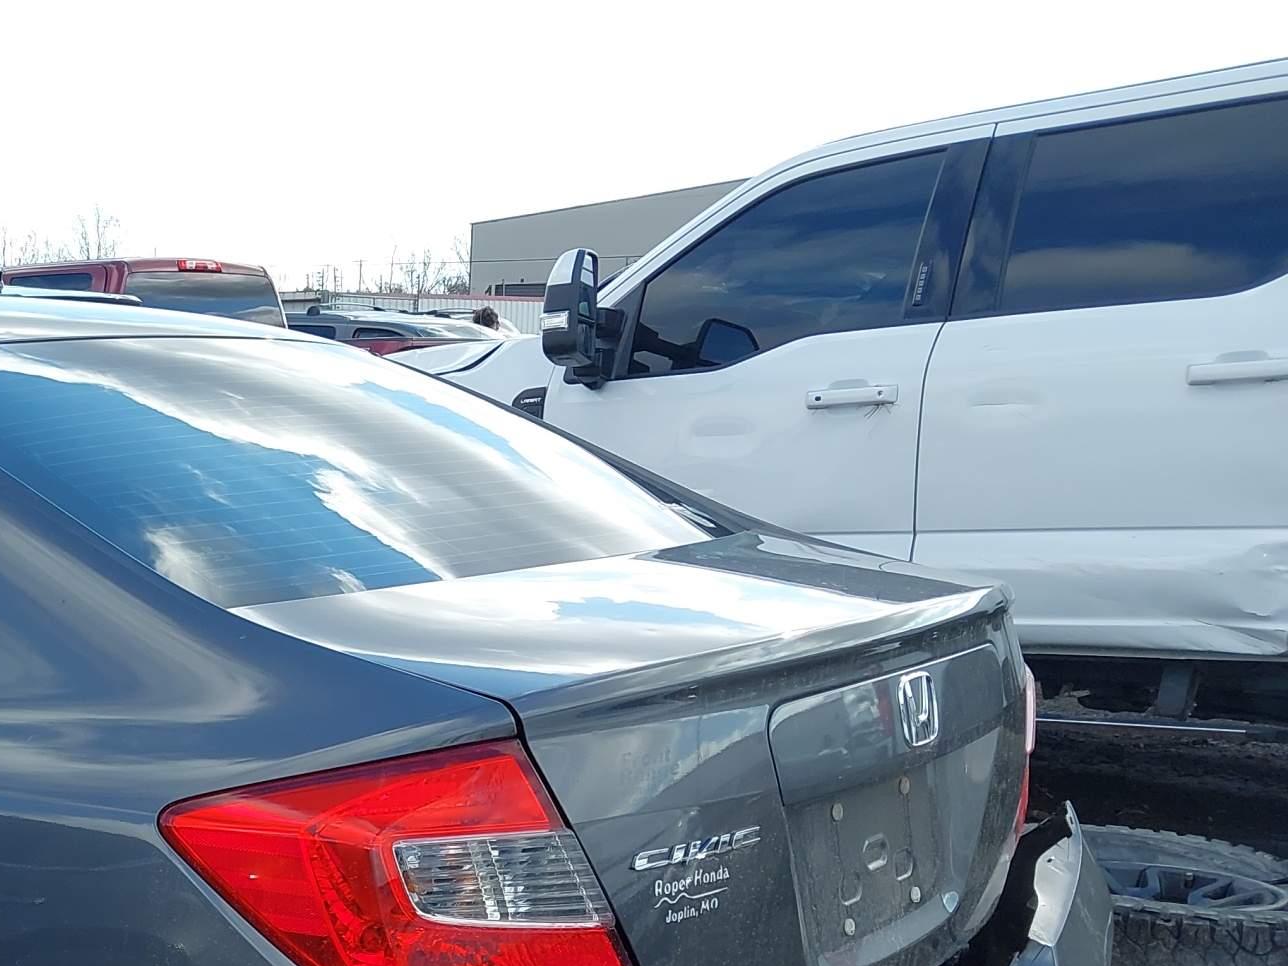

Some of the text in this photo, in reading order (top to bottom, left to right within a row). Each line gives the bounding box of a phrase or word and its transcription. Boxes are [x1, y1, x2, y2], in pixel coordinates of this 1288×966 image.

[633, 826, 761, 871] CIVIC
[654, 866, 730, 897] Roper Honda
[666, 897, 719, 923] Joplin, MO
